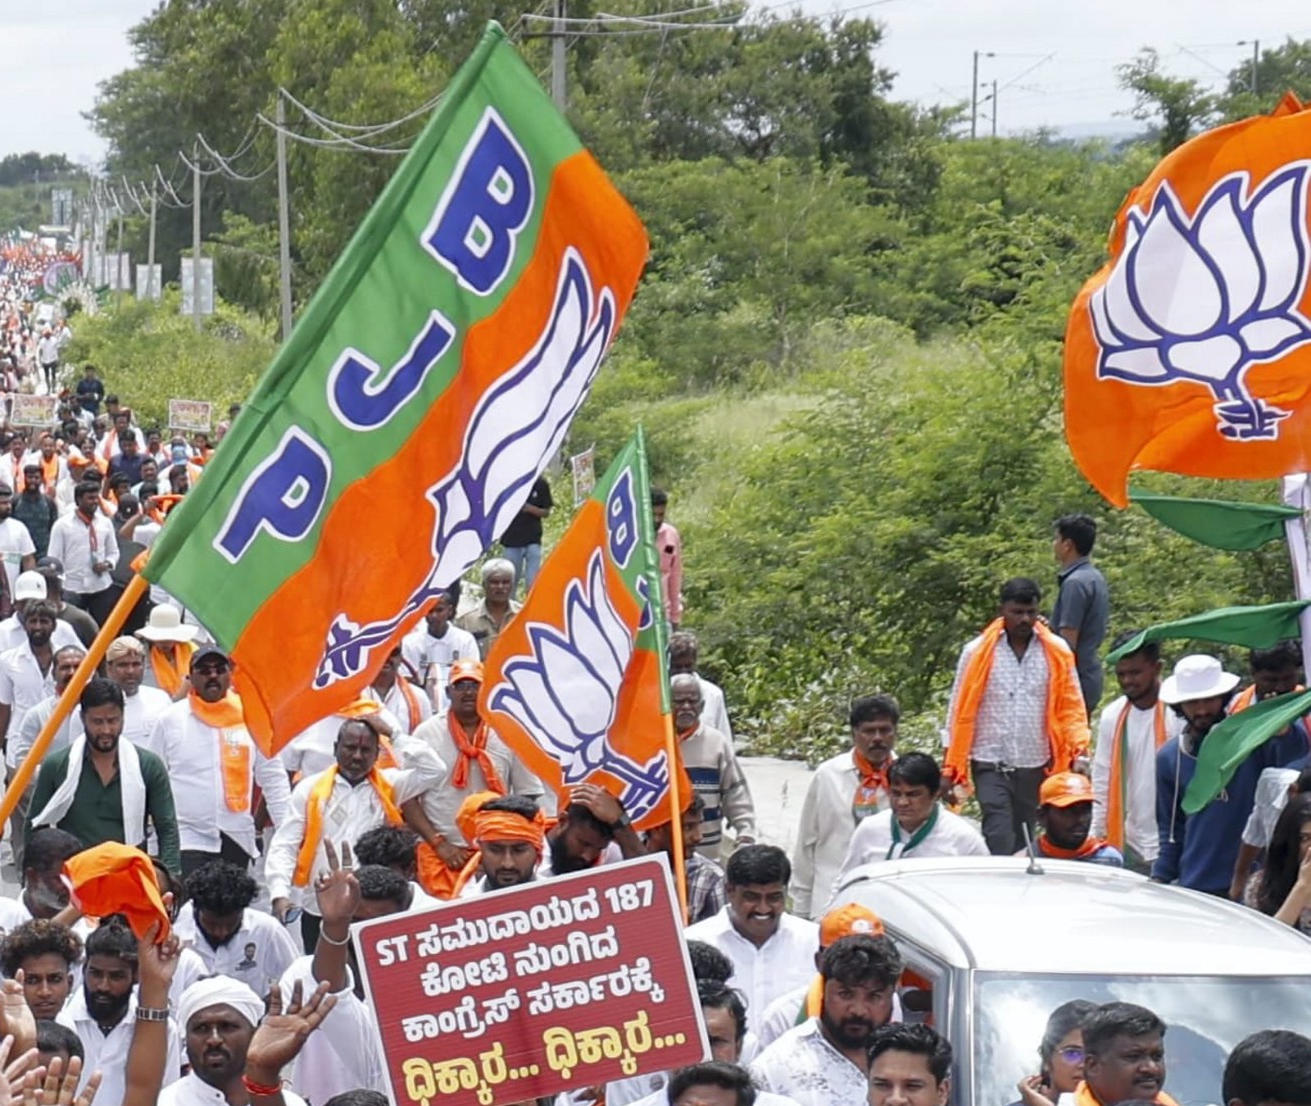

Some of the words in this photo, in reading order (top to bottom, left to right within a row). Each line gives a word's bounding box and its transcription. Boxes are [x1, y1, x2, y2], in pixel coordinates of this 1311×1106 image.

[212, 105, 534, 564] BJP
[376, 935, 408, 966] ST
[415, 887, 601, 958] ಸಮುದಾಯದ
[604, 879, 655, 914] 187
[420, 950, 508, 998] ಕೋಟಿ
[514, 926, 619, 977] ನುಂಗಿದ
[402, 987, 521, 1043] ಕಾಂಗ್ರೆಸ್
[528, 956, 665, 1016] ಸರ್ಕಾರಕ್ಕೆ
